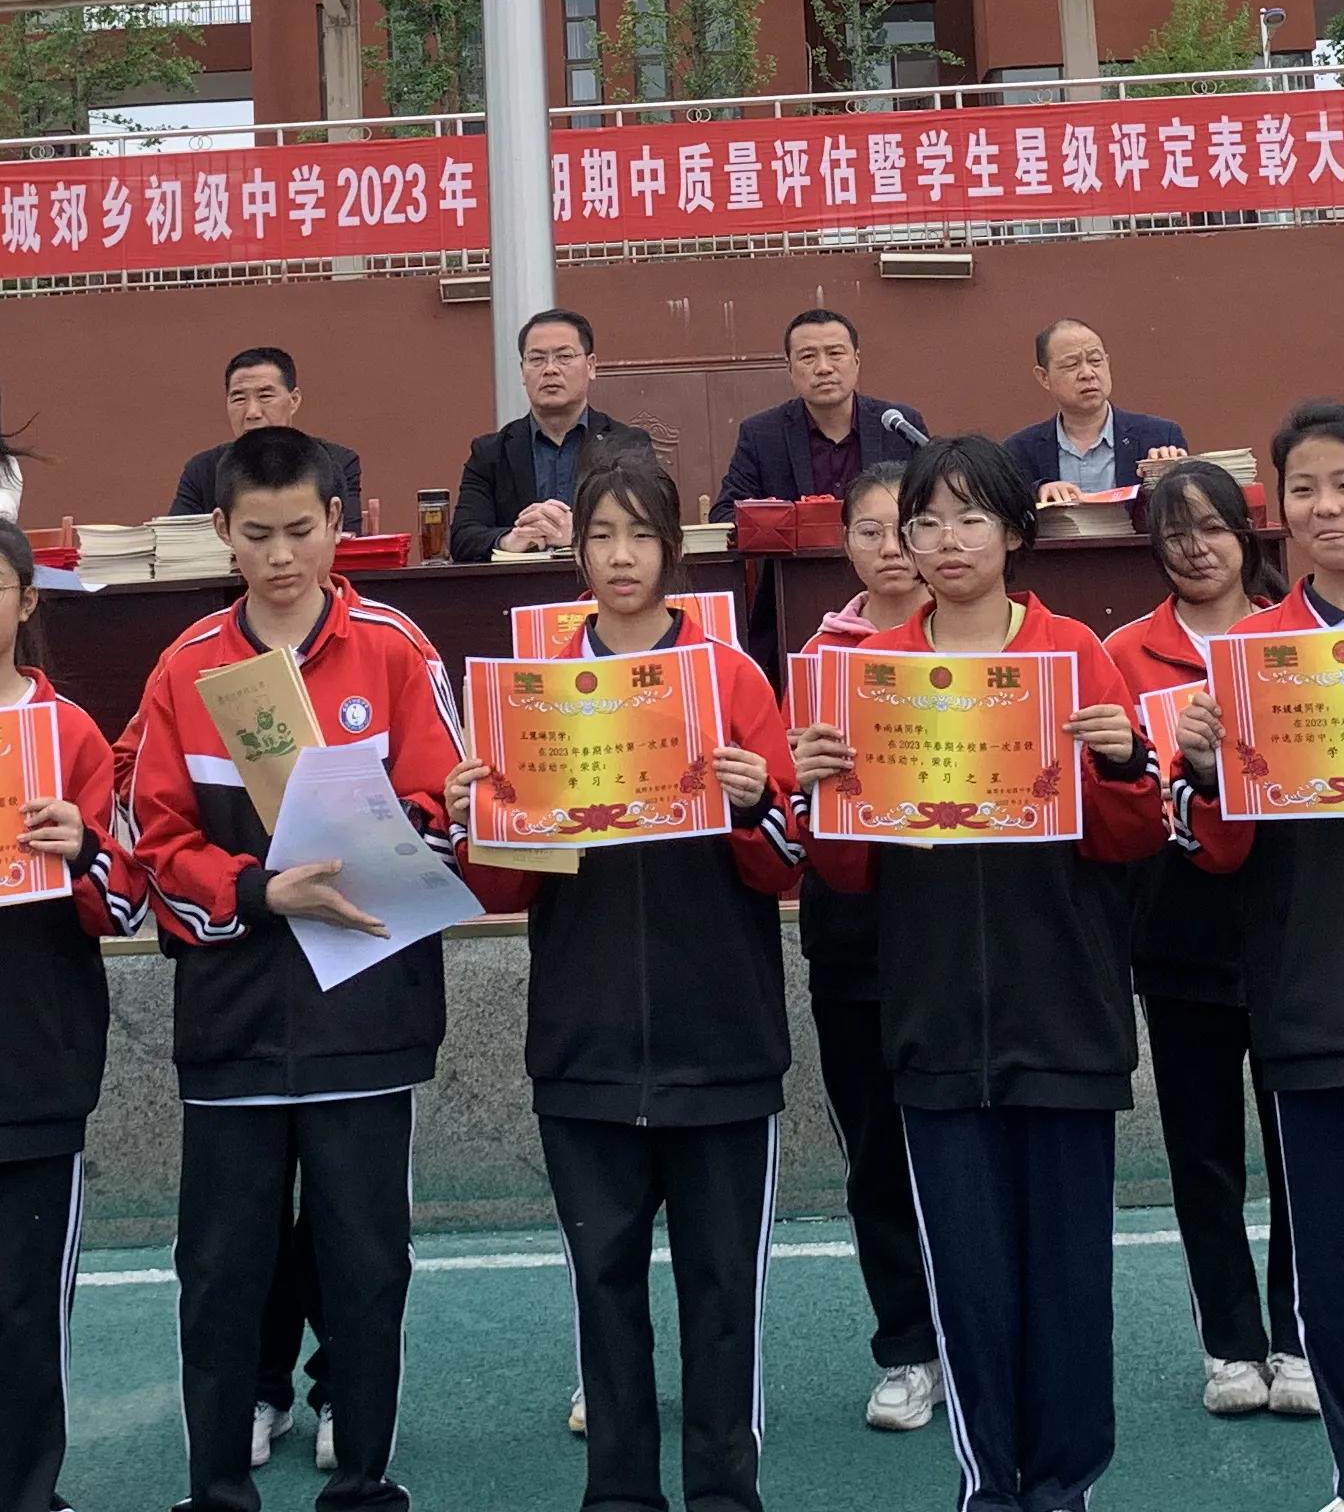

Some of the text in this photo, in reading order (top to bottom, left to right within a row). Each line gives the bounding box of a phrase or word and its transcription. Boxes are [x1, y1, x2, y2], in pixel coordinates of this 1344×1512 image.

[568, 771, 650, 789] 学习之星
[918, 771, 1001, 784] 学习之星
